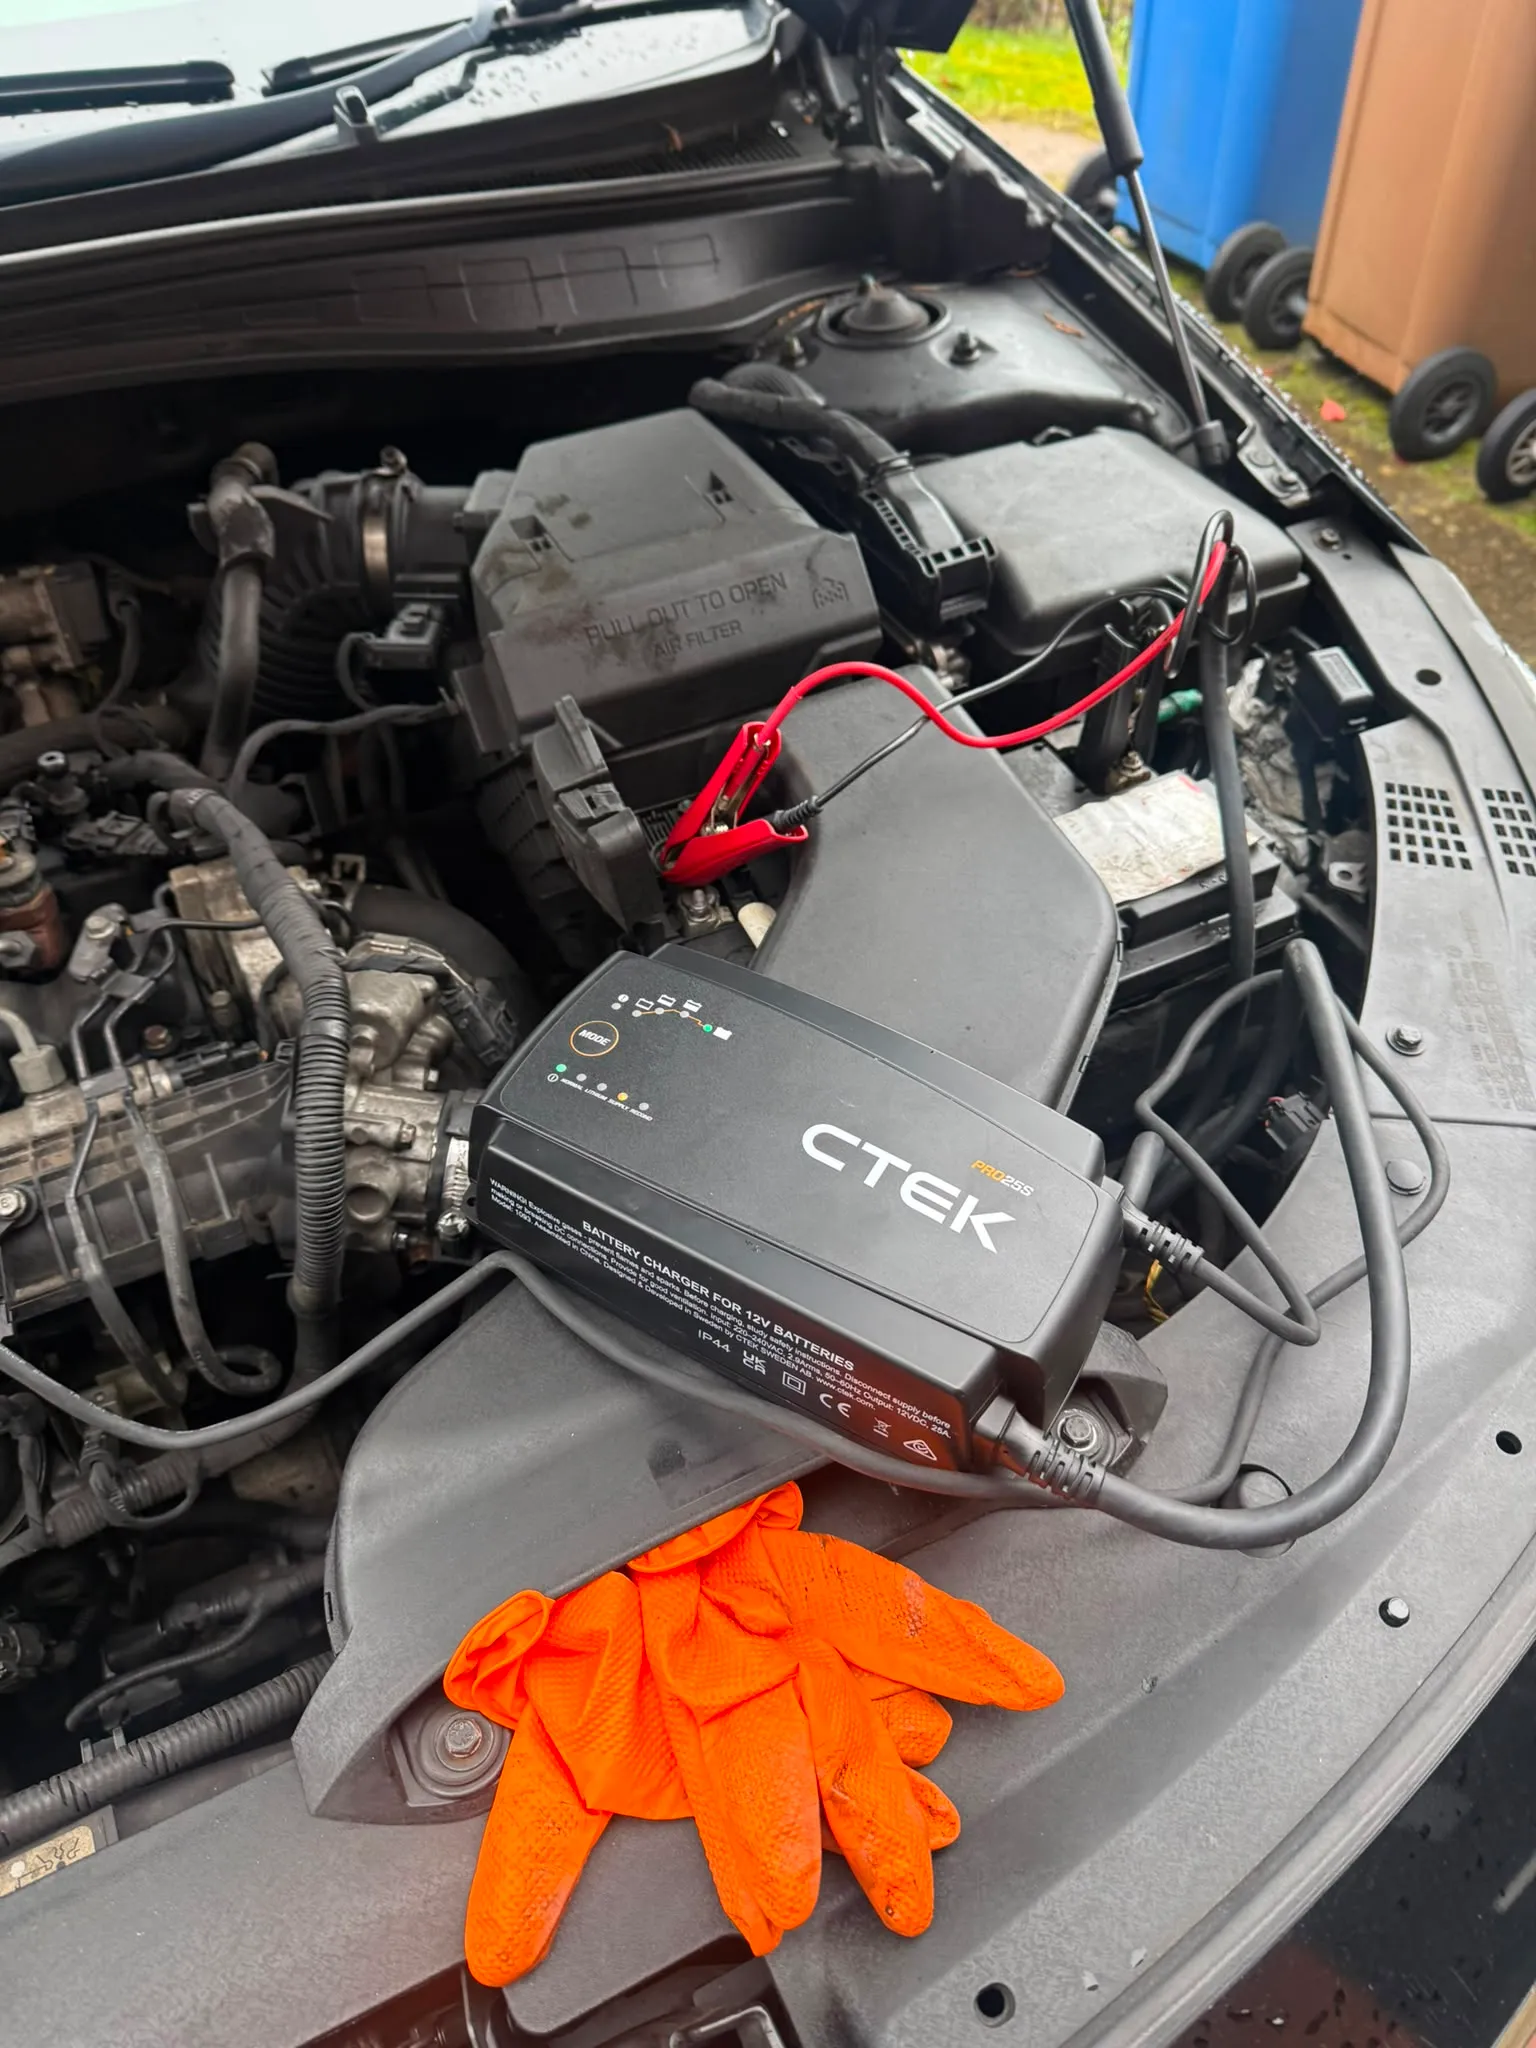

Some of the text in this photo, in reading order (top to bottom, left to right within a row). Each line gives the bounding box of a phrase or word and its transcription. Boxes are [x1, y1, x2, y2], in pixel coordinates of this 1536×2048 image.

[583, 572, 787, 647] PULL OUT TO OPEN
[653, 620, 743, 659] AIR FILTER
[578, 1029, 611, 1046] MODE
[584, 1088, 608, 1101] LITHIUM
[607, 1098, 629, 1112] SUPPLY
[629, 1107, 653, 1121] RECOND
[802, 1123, 1016, 1254] CTEK
[970, 1159, 1034, 1197] PRO25S
[490, 1178, 527, 1205] WARNING!
[529, 1201, 561, 1224] Explosive
[562, 1222, 582, 1237] gases
[589, 1237, 615, 1256] prevent
[616, 1251, 639, 1270] flames
[641, 1267, 654, 1278] and
[656, 1276, 682, 1293] sparks.
[684, 1289, 708, 1307] Before
[710, 1304, 744, 1327] charging,
[747, 1323, 768, 1339] study
[770, 1333, 793, 1352] safety
[795, 1348, 841, 1377] instructions.
[844, 1372, 891, 1401] Disconnect
[892, 1397, 921, 1415] supply
[922, 1411, 951, 1429] before
[491, 1188, 514, 1206] making
[524, 1208, 553, 1229] breaking
[554, 1224, 565, 1235] DC
[567, 1233, 608, 1261] connections.
[611, 1257, 637, 1277] Provide
[639, 1274, 649, 1283] for
[650, 1281, 668, 1295] good
[670, 1291, 708, 1316] ventilation.
[711, 1312, 731, 1328] Input:
[863, 1391, 894, 1411] Output:
[897, 1408, 929, 1429] 12VDC,
[931, 1424, 951, 1439] 25A.
[492, 1194, 513, 1212] Model:
[534, 1221, 571, 1246] Assembled
[572, 1243, 579, 1251] in
[580, 1247, 602, 1265] China.
[604, 1261, 636, 1284] Designed
[645, 1284, 683, 1311] Developed
[685, 1307, 692, 1315] in
[693, 1311, 723, 1332] Sweden
[725, 1328, 734, 1338] by
[736, 1333, 759, 1351] CTEK
[760, 1346, 798, 1371] SWEDEN
[800, 1365, 814, 1379] AB.
[816, 1377, 876, 1410] www.ctek.com.
[583, 1220, 854, 1371] BATTERY CHARGER FOR 12V BATTERIES
[698, 1329, 731, 1353] IP44
